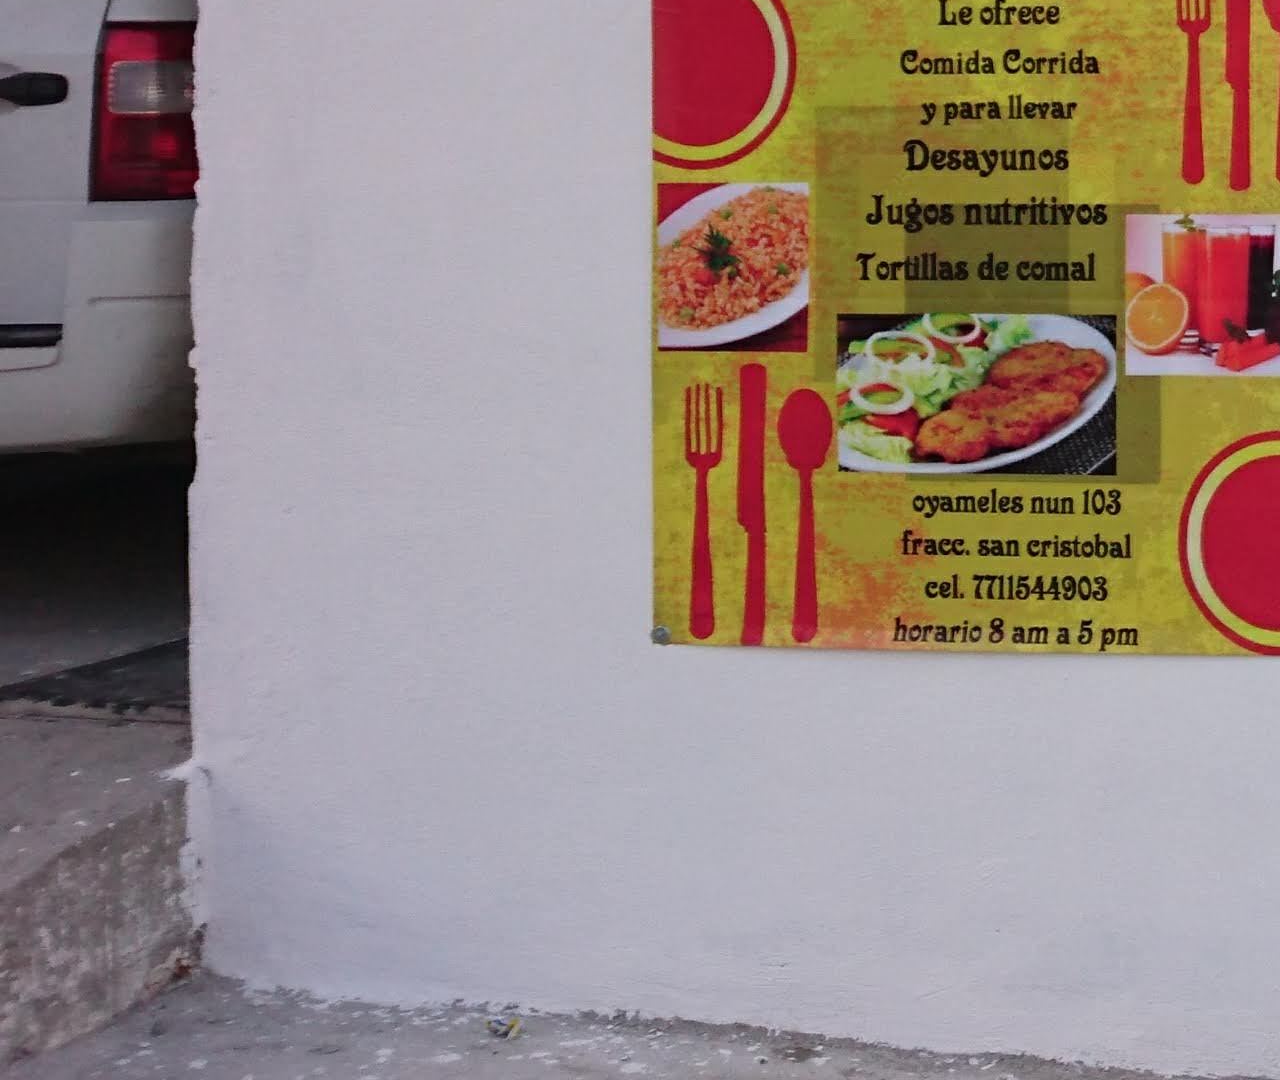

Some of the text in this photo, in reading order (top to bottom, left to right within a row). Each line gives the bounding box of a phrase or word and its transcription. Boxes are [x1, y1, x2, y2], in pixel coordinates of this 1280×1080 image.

[899, 48, 1100, 75] Comida Corrida
[919, 94, 1078, 127] y para llevar
[904, 139, 1070, 177] Desayunos
[866, 195, 1107, 233] Jugos nutritivos
[856, 252, 1096, 282] Tortillas de comal
[912, 487, 1122, 519] oyameles nun 103
[901, 529, 1132, 559] fracc. san cristobal
[924, 573, 1109, 602] cel. 7711544903
[893, 616, 1139, 652] horario 8 am a 5 pm
